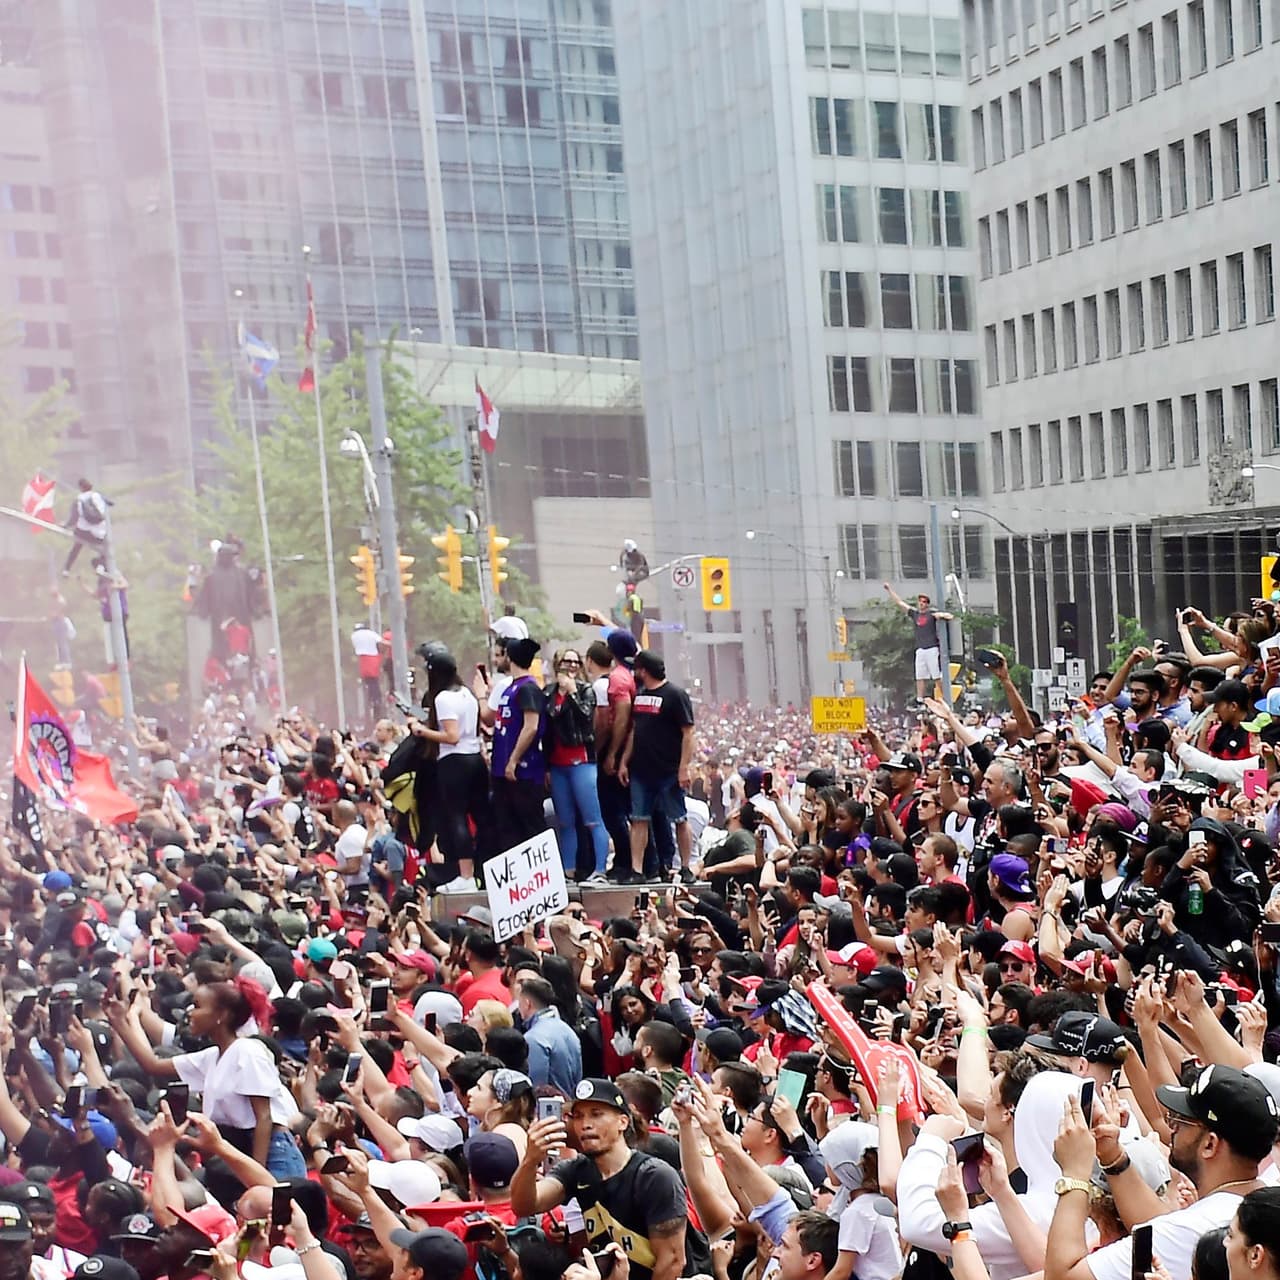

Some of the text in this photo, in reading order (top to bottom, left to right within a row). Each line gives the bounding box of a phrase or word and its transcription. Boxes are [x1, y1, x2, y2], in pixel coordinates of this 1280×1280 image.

[825, 711, 851, 720] BLOCK
[491, 840, 551, 890] WE THE
[508, 871, 551, 906] NORTH
